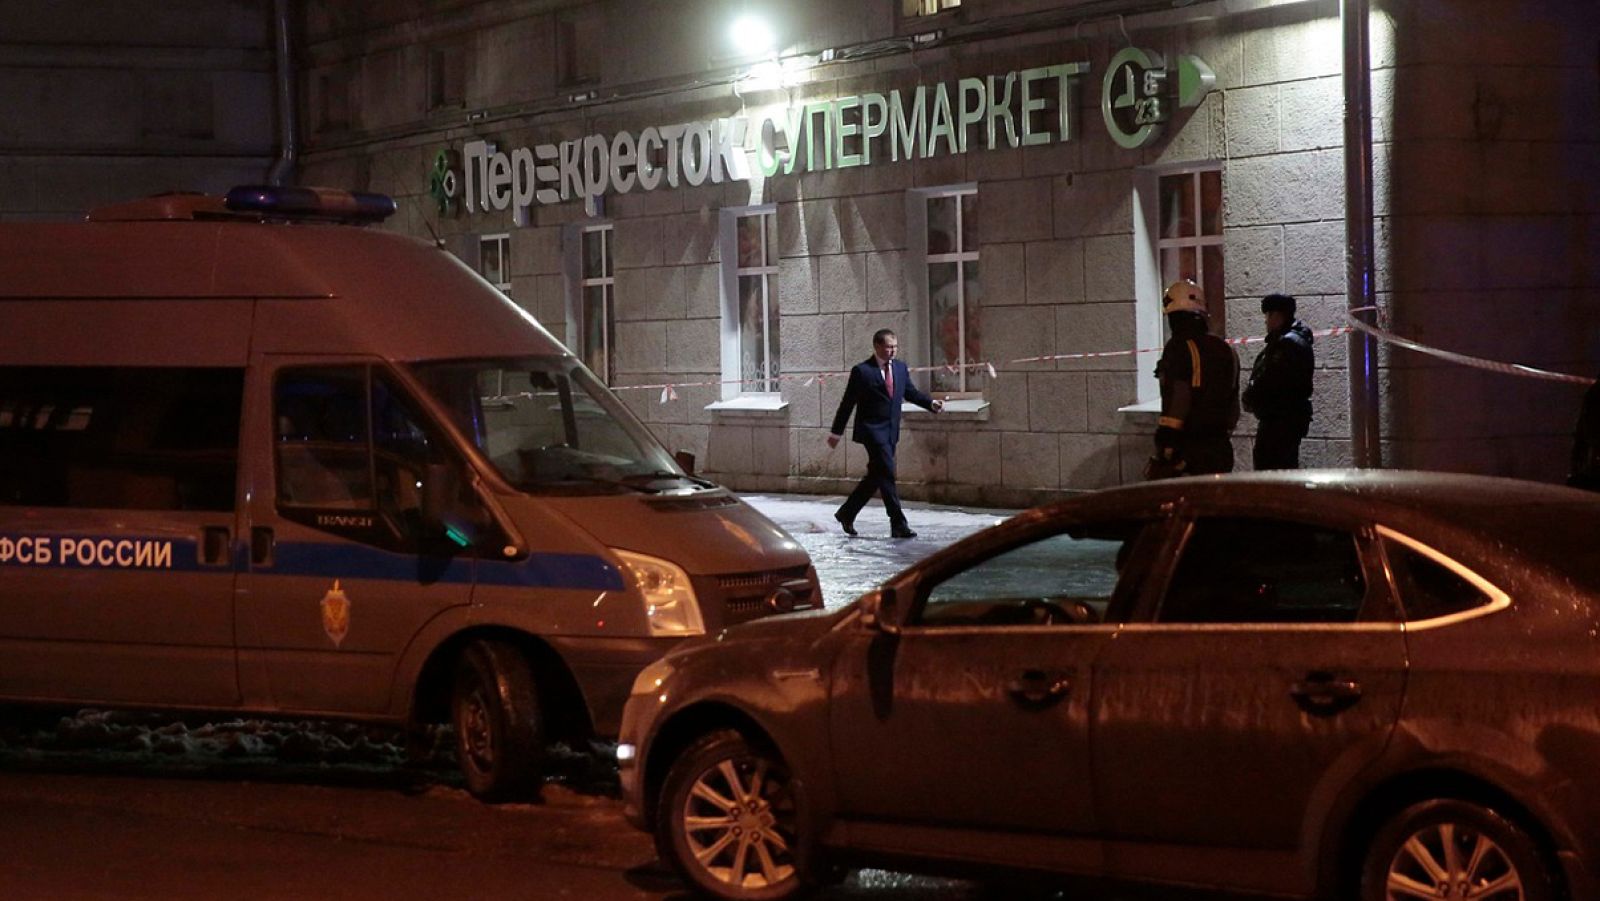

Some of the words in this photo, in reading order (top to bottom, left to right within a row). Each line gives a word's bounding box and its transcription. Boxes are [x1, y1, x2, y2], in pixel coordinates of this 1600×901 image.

[756, 62, 1080, 177] СУПЕРМАРКЕТ
[317, 514, 374, 527] TRANSIT
[0, 536, 53, 564] ФСБ
[59, 537, 173, 569] РОССИИ
